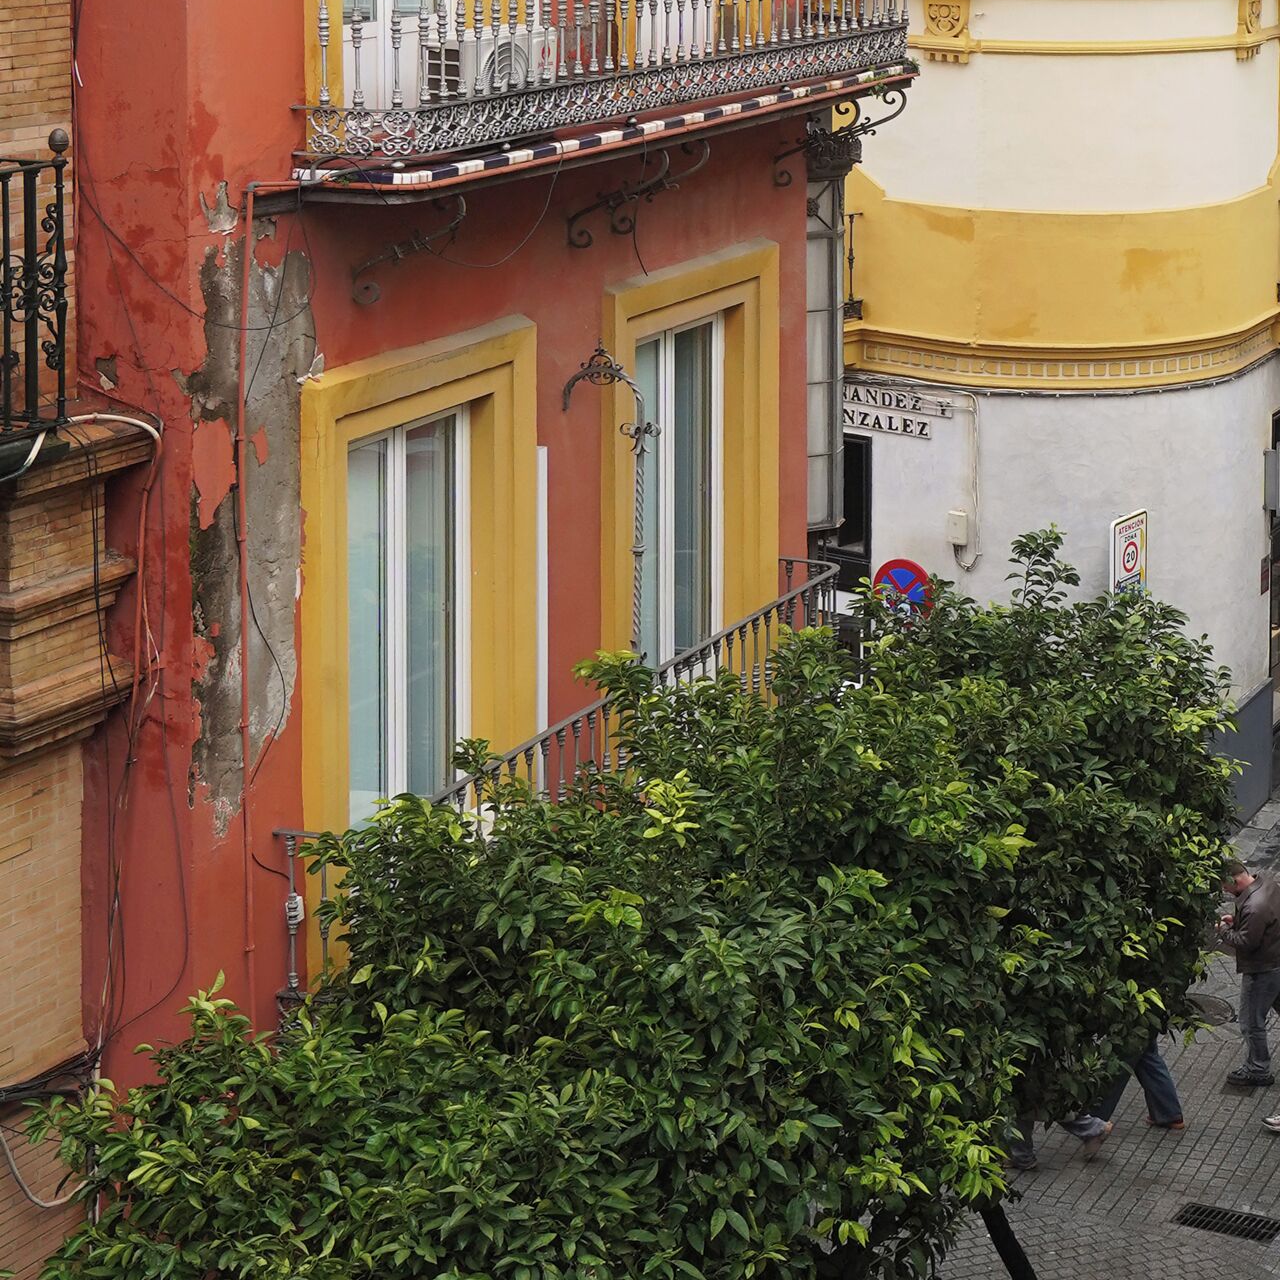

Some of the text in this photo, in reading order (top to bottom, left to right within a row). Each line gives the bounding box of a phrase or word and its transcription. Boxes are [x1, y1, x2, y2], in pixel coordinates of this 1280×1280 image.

[1119, 519, 1144, 534] ATENCIÓN
[1124, 533, 1136, 542] ZONA
[1126, 550, 1135, 563] 20
